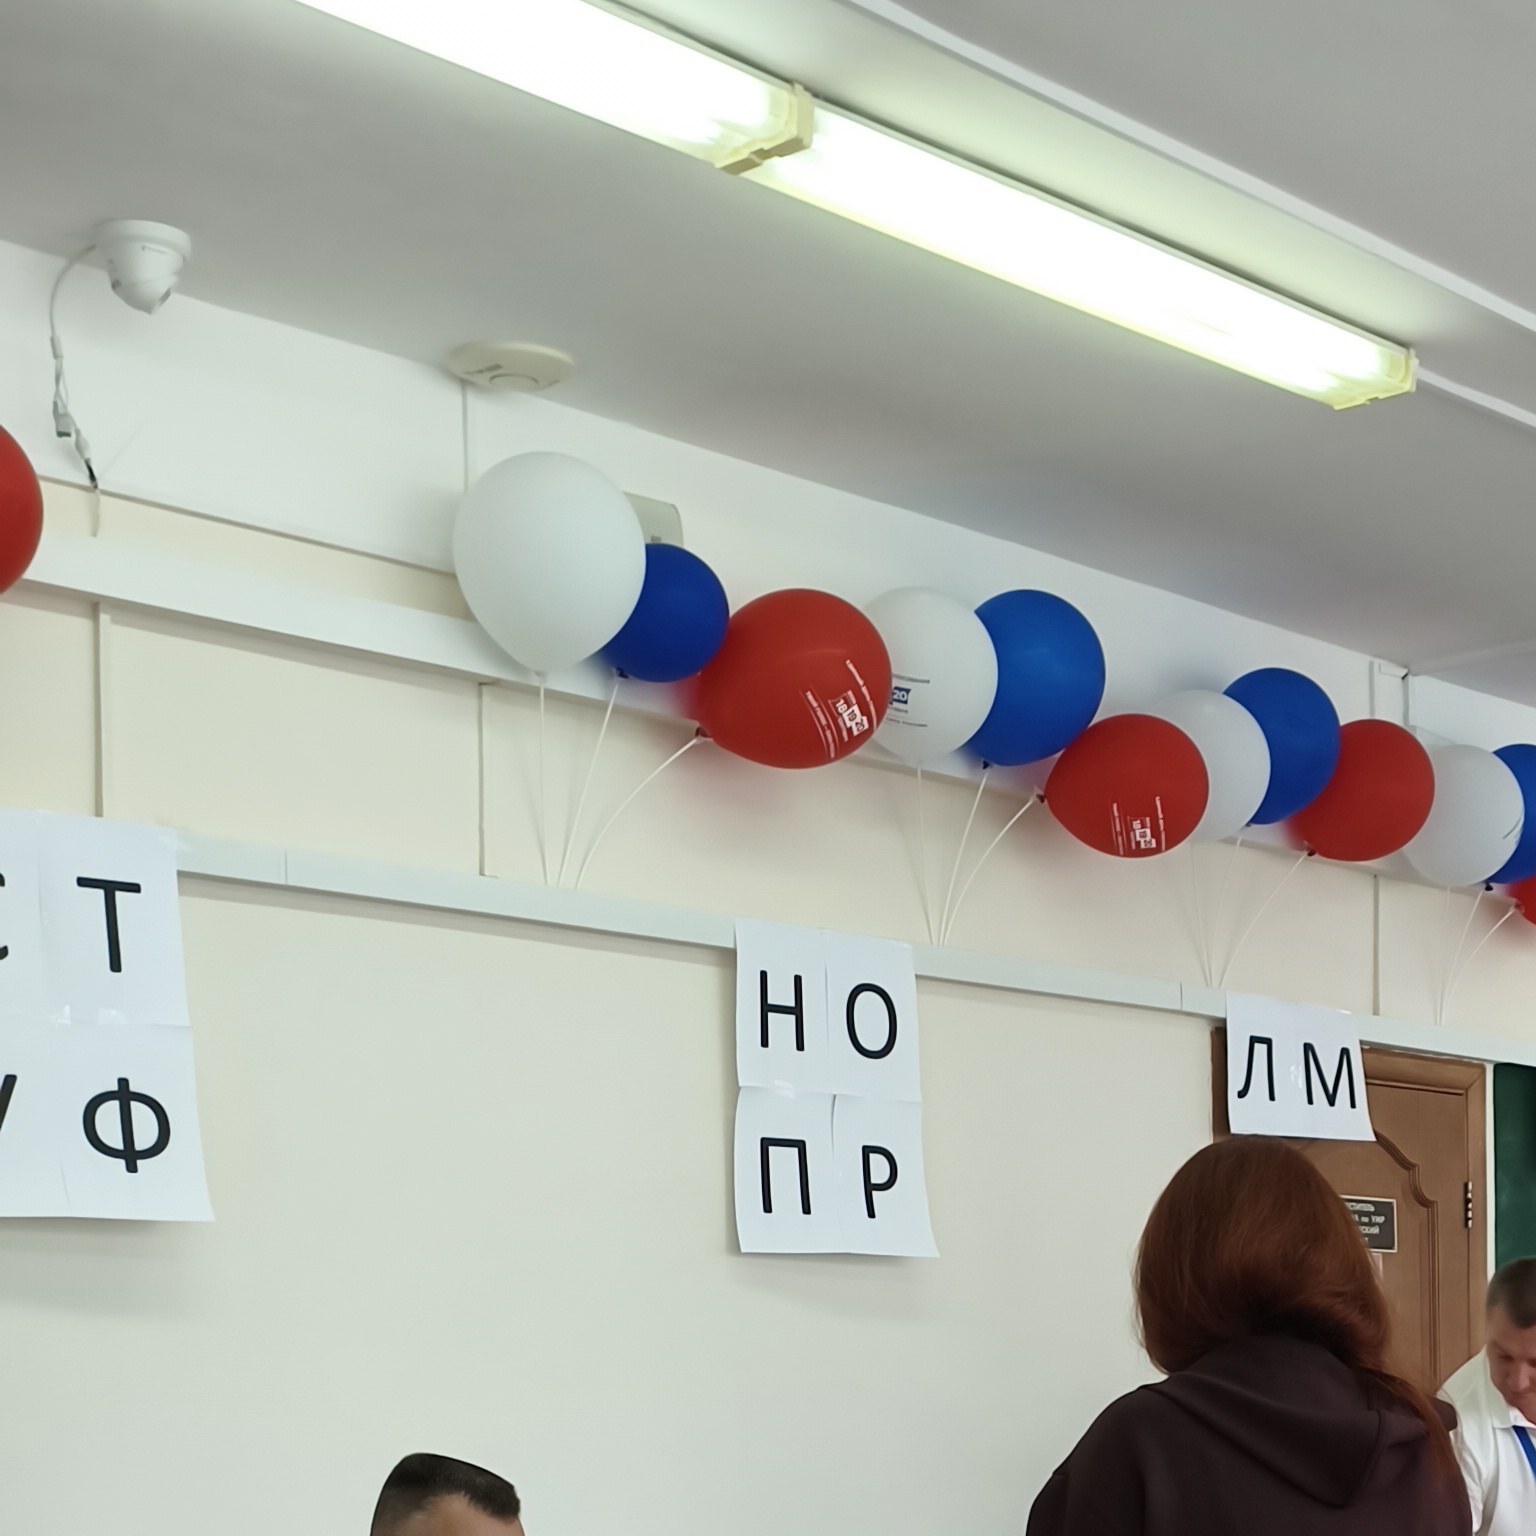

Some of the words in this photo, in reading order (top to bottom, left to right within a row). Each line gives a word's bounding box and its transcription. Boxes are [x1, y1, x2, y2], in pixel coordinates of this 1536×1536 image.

[835, 699, 848, 713] 18
[846, 709, 857, 722] 19
[892, 689, 907, 702] 20
[76, 876, 141, 973] Т
[82, 1077, 171, 1173] Ф
